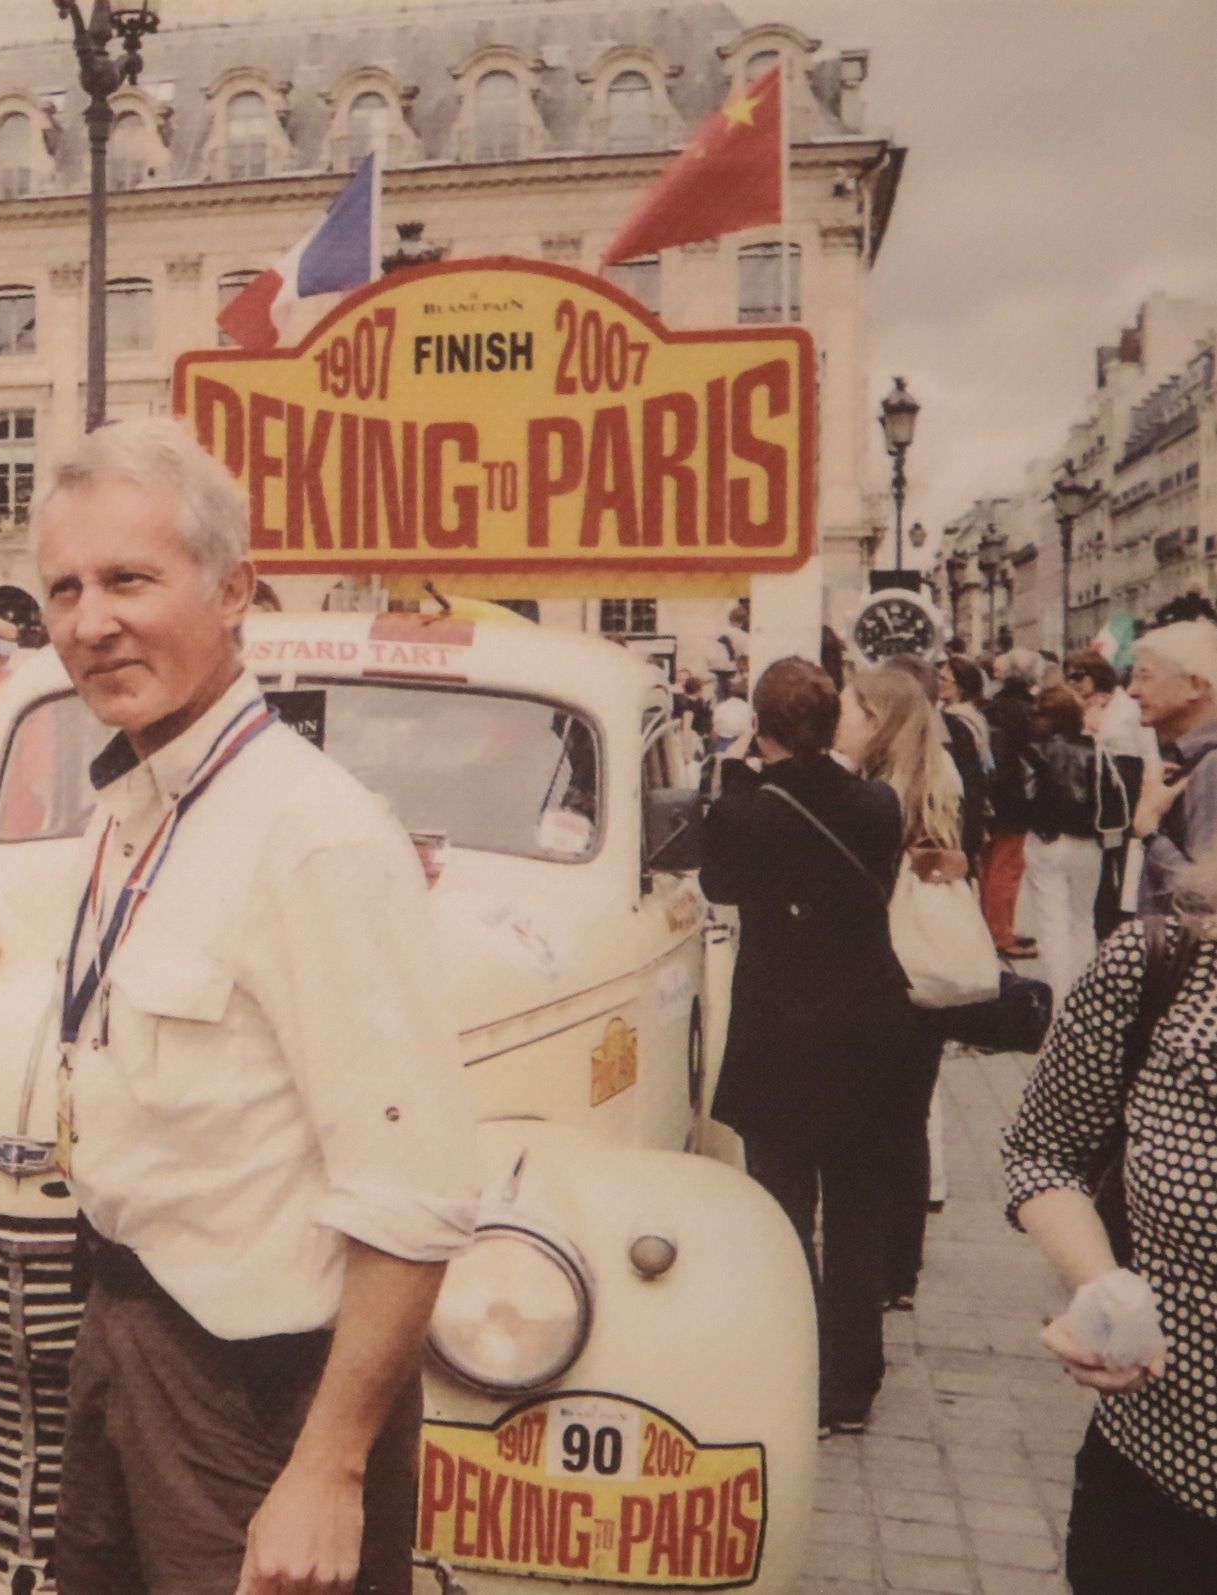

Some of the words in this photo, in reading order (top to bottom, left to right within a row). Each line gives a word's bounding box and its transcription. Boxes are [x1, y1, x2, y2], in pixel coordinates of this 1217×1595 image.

[314, 306, 397, 402] 1907
[413, 331, 533, 375] FINISH
[554, 298, 650, 396] 2007
[481, 460, 518, 513] TO
[526, 357, 791, 548] PARIS
[368, 643, 449, 668] TART
[495, 1411, 548, 1467] 1907
[561, 1423, 622, 1476] 90
[641, 1422, 696, 1478] 2007
[419, 1440, 593, 1570] PEKING
[617, 1466, 760, 1578] PARIS
